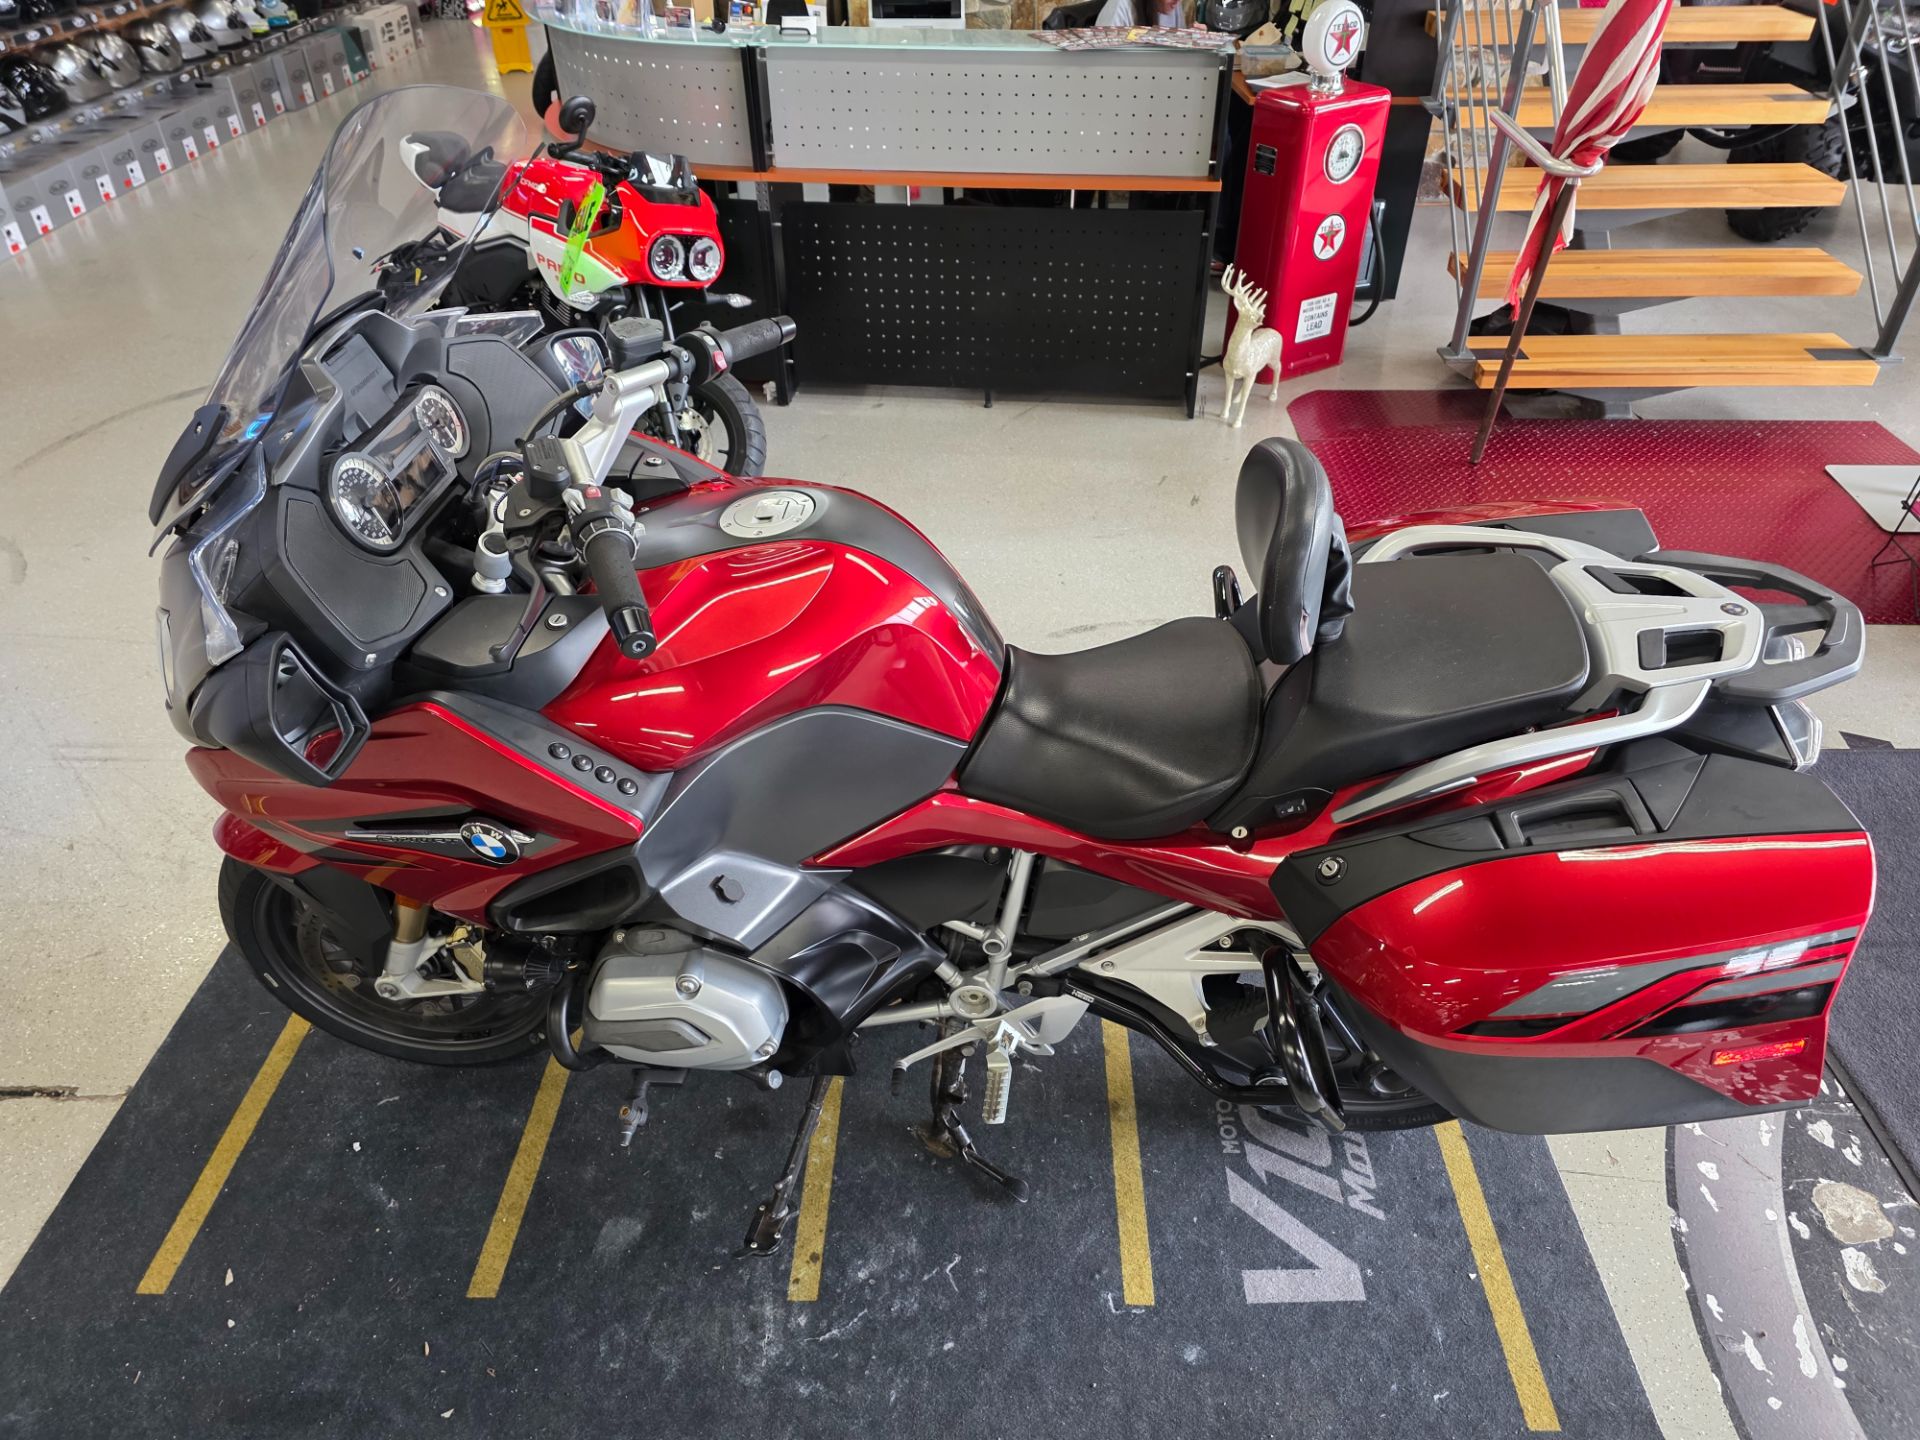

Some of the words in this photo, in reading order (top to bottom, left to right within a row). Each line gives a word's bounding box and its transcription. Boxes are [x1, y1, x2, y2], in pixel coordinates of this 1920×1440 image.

[1304, 310, 1328, 322] CONTAINS
[1306, 320, 1322, 332] LEAD
[1216, 1100, 1241, 1154] MOTO
